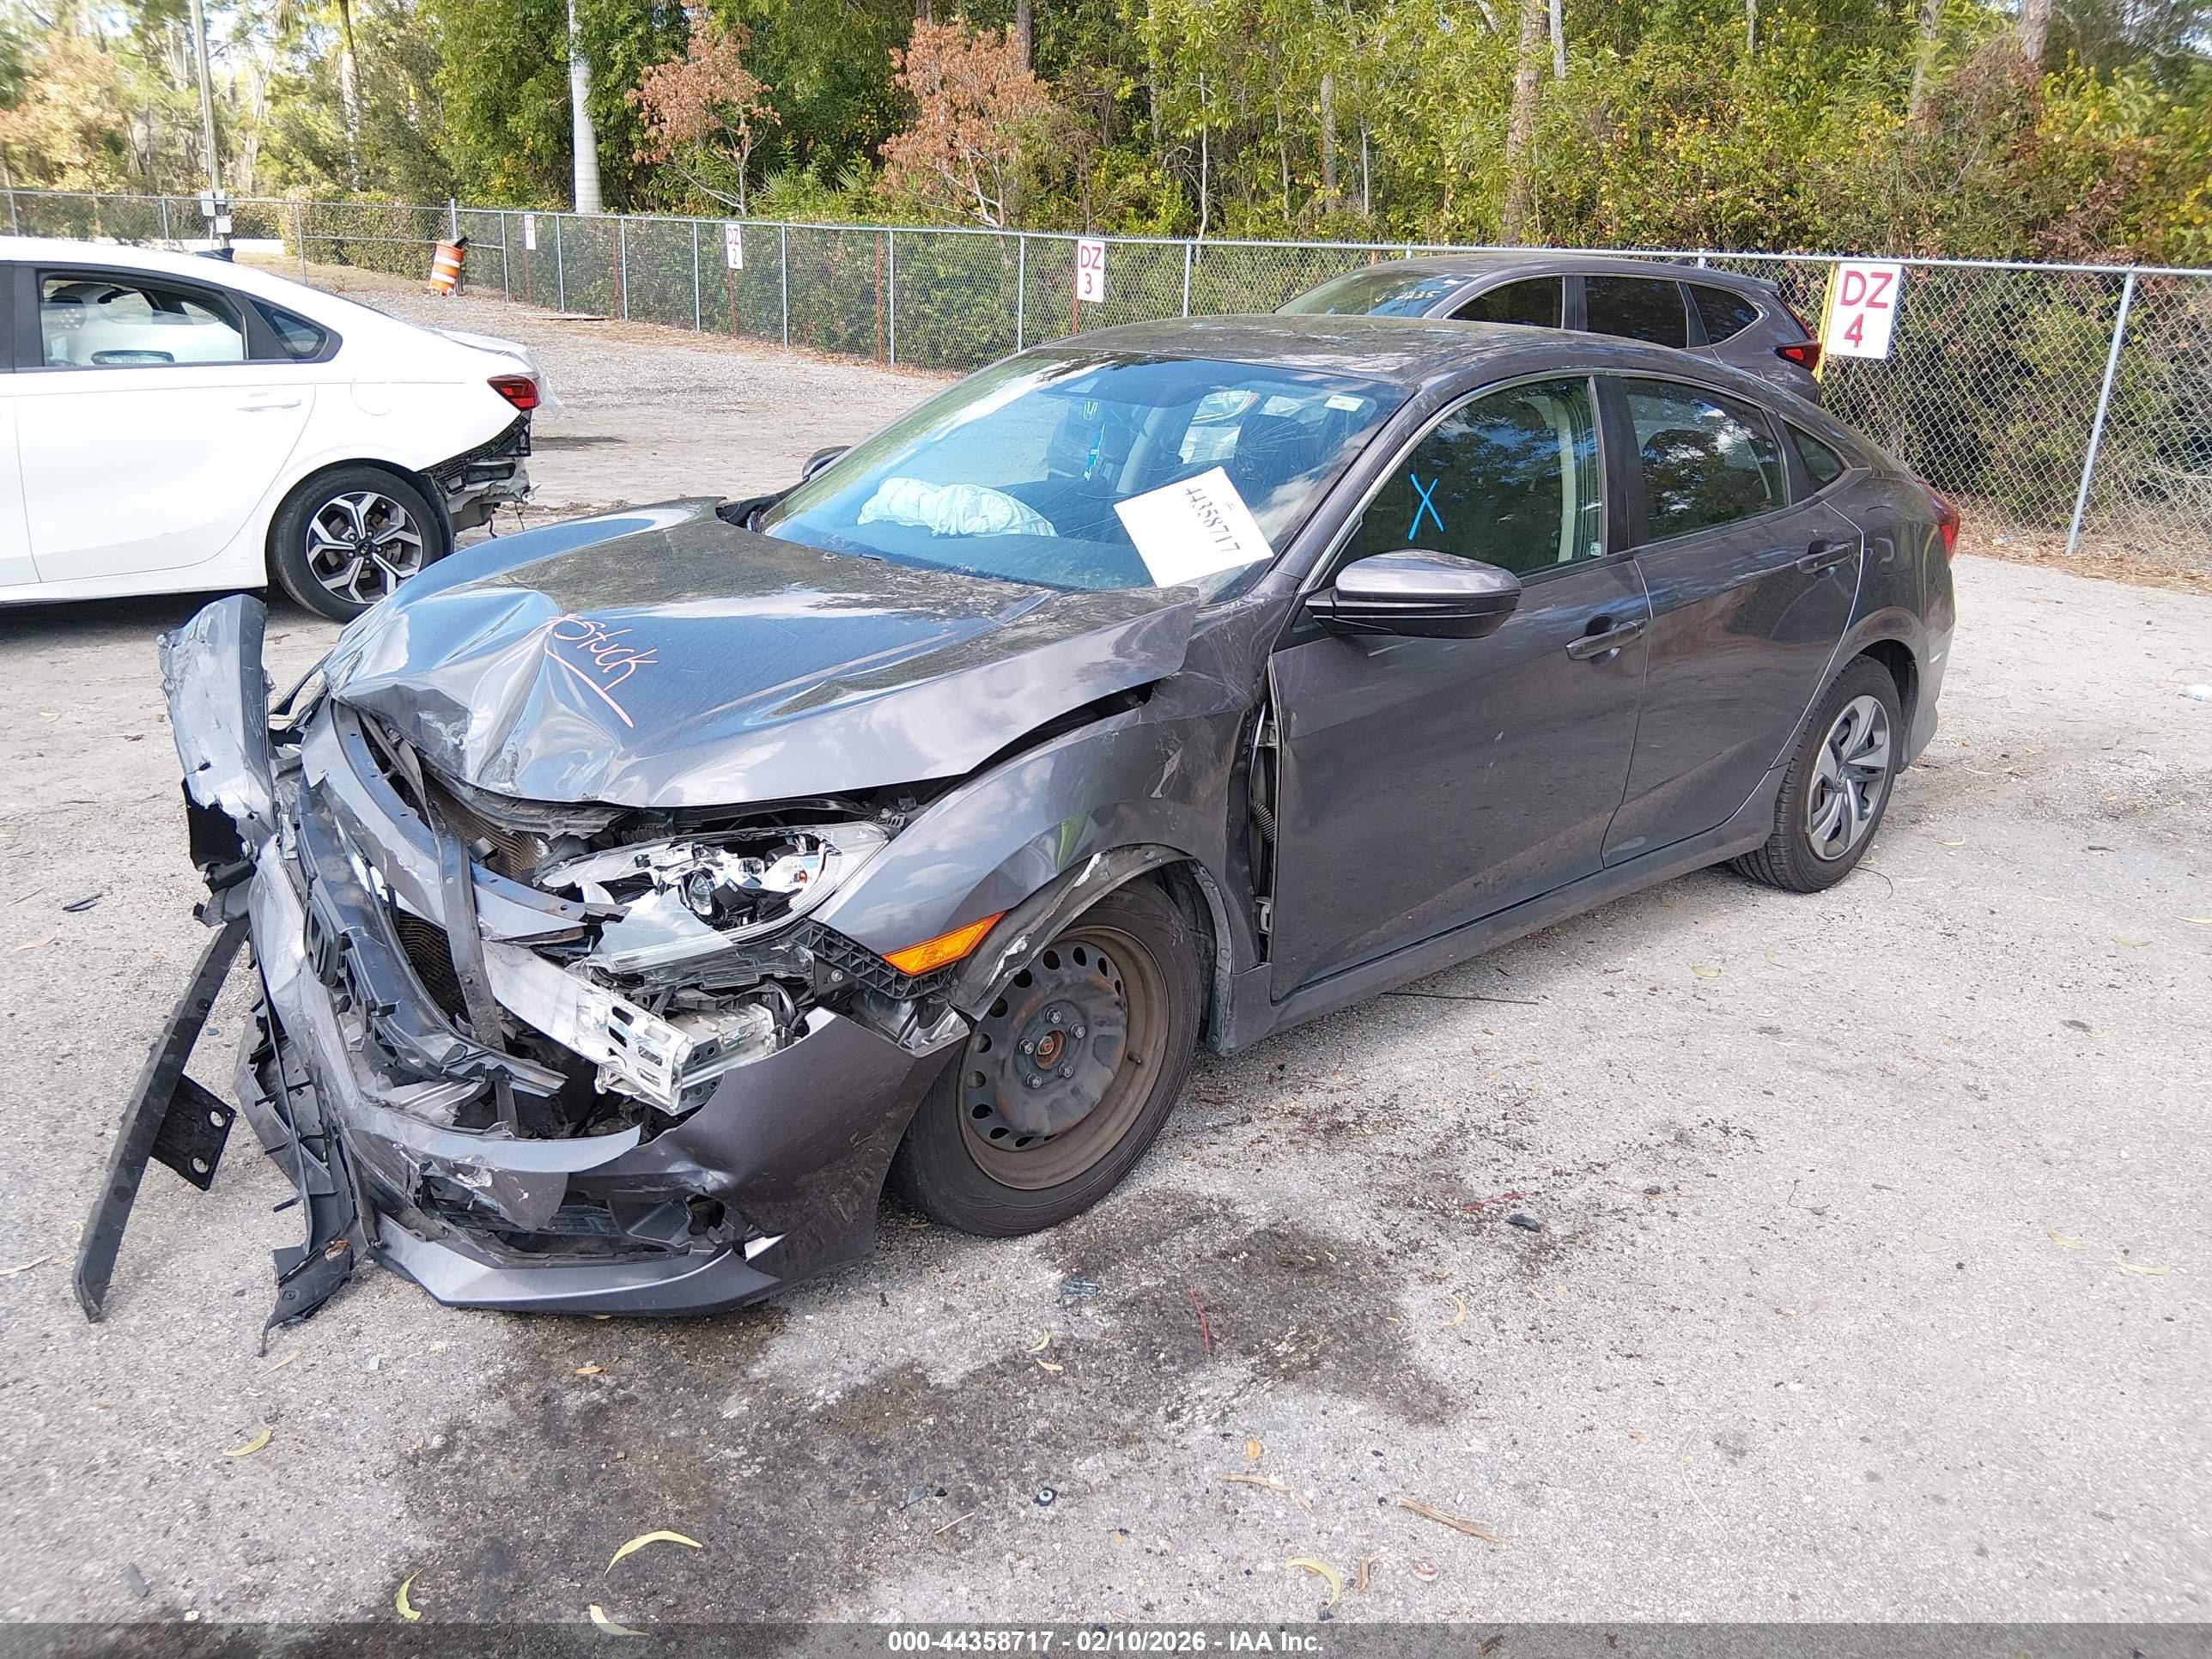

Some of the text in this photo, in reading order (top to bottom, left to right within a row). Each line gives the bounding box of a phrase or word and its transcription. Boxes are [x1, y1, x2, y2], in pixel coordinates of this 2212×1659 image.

[727, 228, 739, 245] DZ
[732, 248, 738, 264] 2
[1080, 245, 1102, 270] DZ
[1085, 272, 1092, 295] 3
[1840, 270, 1893, 308] DZ
[1844, 313, 1863, 348] 4
[1185, 488, 1241, 552] 44358717
